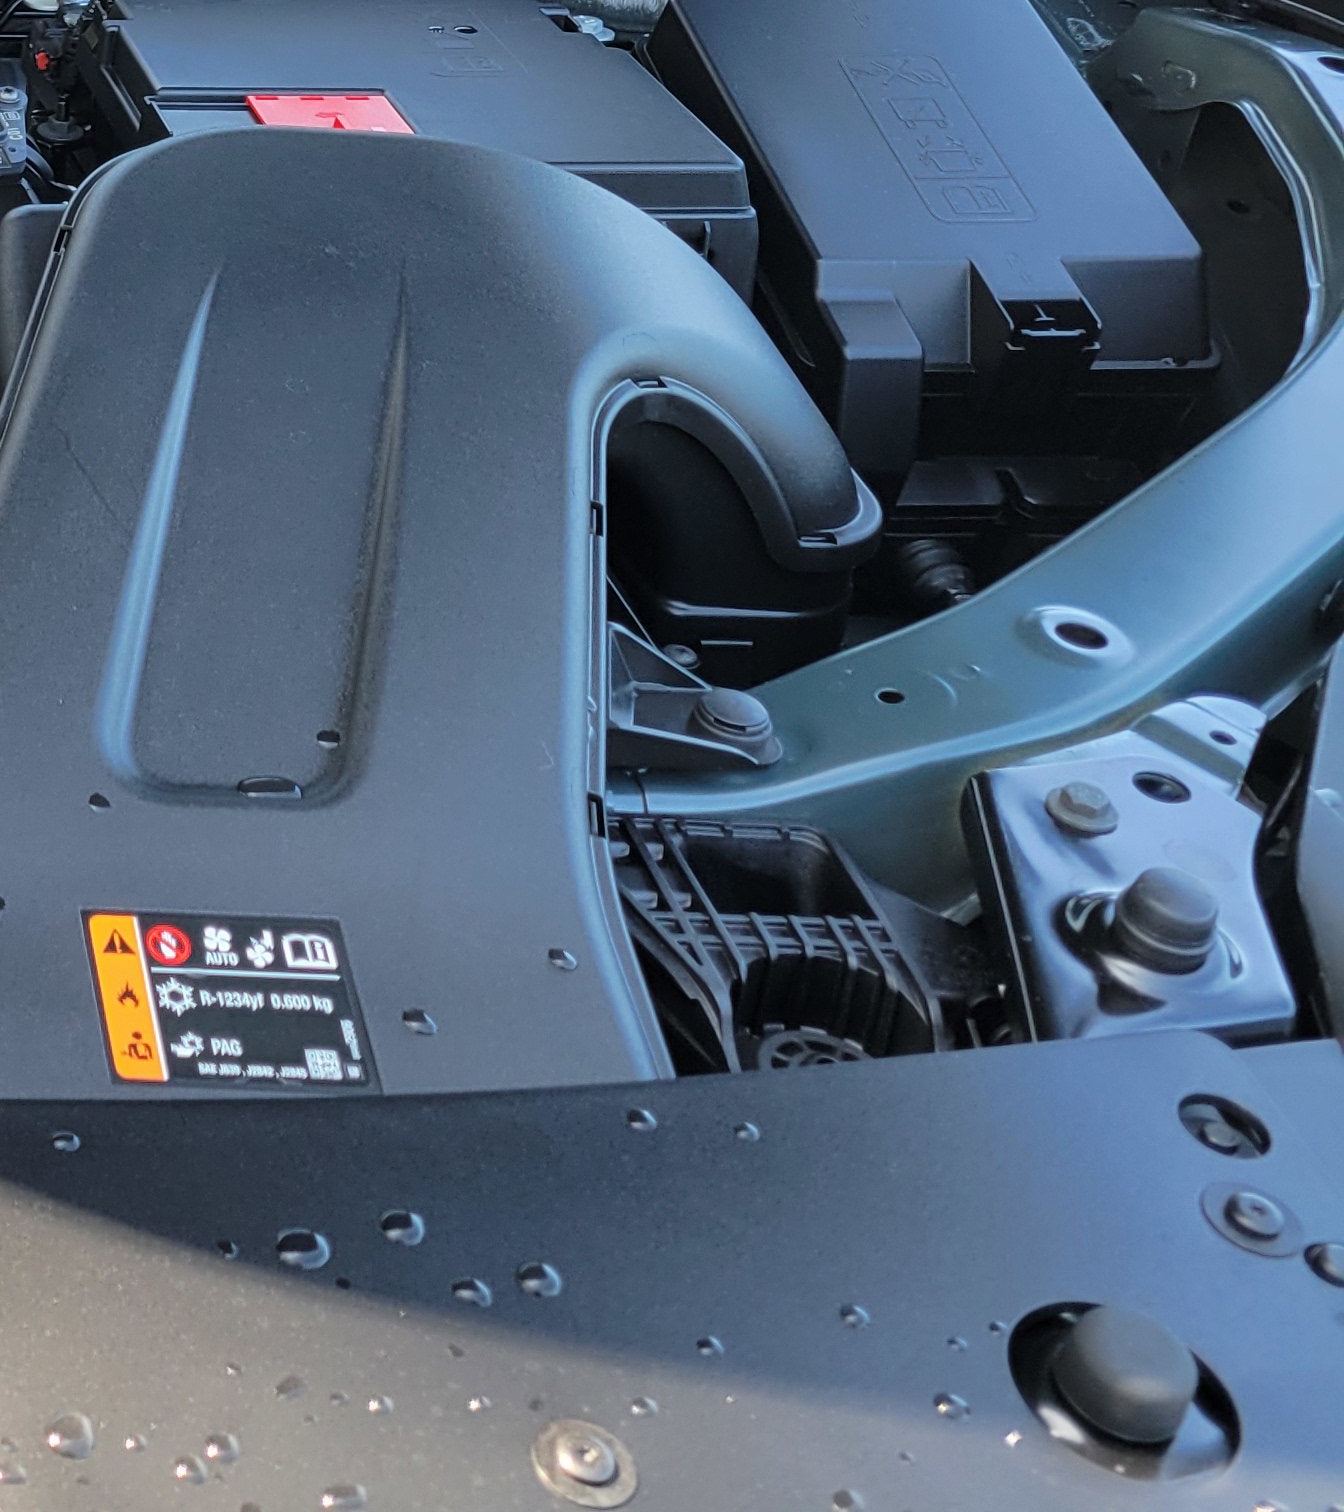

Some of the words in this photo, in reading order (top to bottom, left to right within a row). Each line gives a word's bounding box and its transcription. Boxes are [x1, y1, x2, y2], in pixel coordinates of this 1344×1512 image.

[205, 952, 239, 967] AUTO
[199, 990, 265, 1011] R-1234yf
[313, 995, 334, 1014] kg
[210, 1038, 243, 1057] PAG
